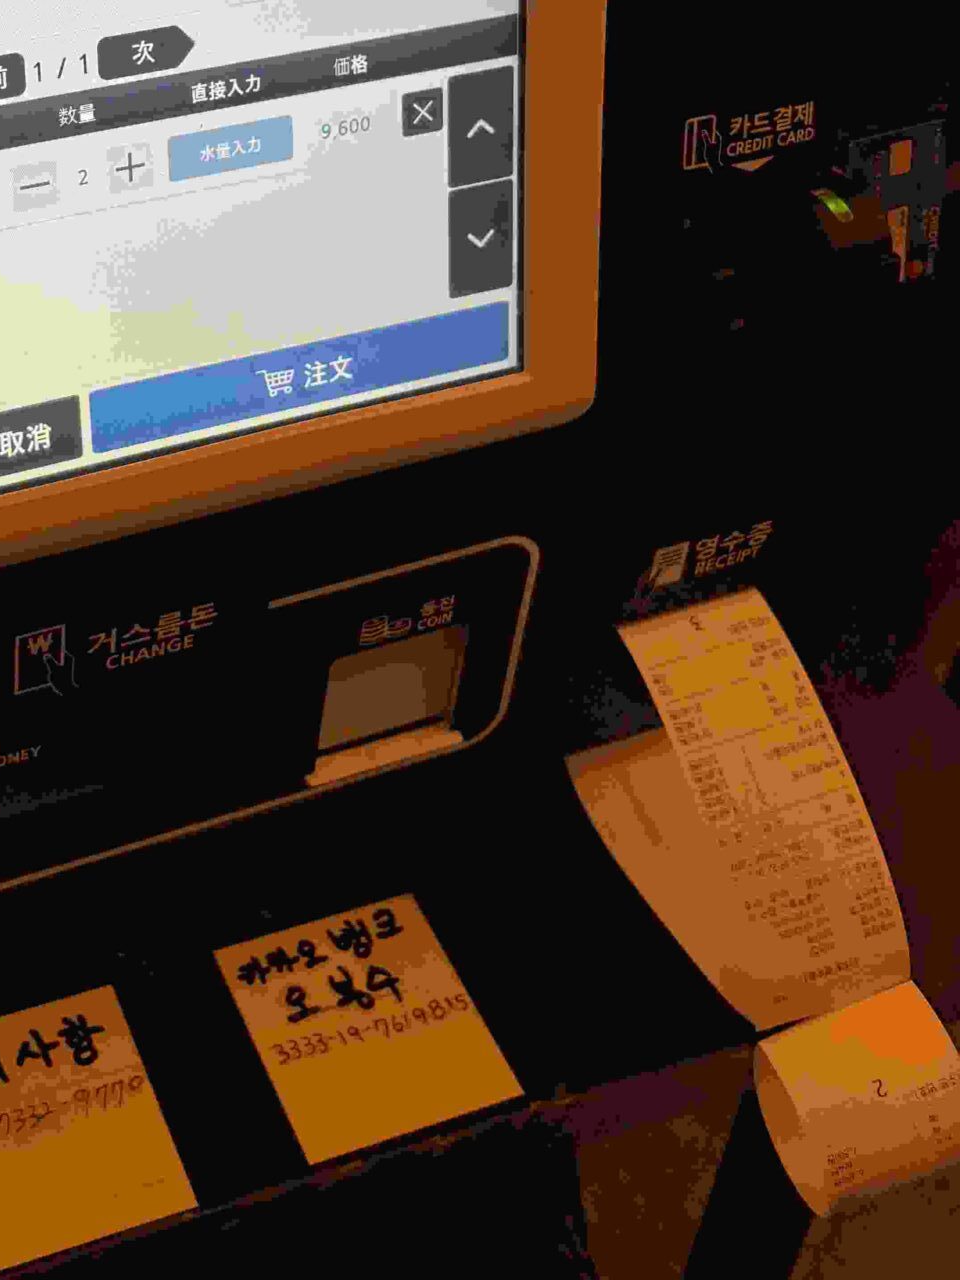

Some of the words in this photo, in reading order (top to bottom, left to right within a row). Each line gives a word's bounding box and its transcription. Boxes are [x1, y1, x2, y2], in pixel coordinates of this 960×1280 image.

[131, 40, 156, 65] 次
[333, 54, 368, 77] 価格
[191, 74, 262, 104] 直接入力
[58, 104, 96, 127] 数量
[320, 116, 371, 141] 9,600
[729, 100, 814, 138] 카드결제
[726, 133, 774, 158] CREDIT
[777, 126, 815, 146] CARD
[78, 169, 89, 186] 2
[303, 357, 354, 388] 注文
[694, 519, 773, 562] 영수증
[694, 543, 763, 577] RECEIPT
[87, 602, 219, 655] 거스름돈
[416, 611, 453, 631] COIN
[105, 632, 196, 670] CHANGE
